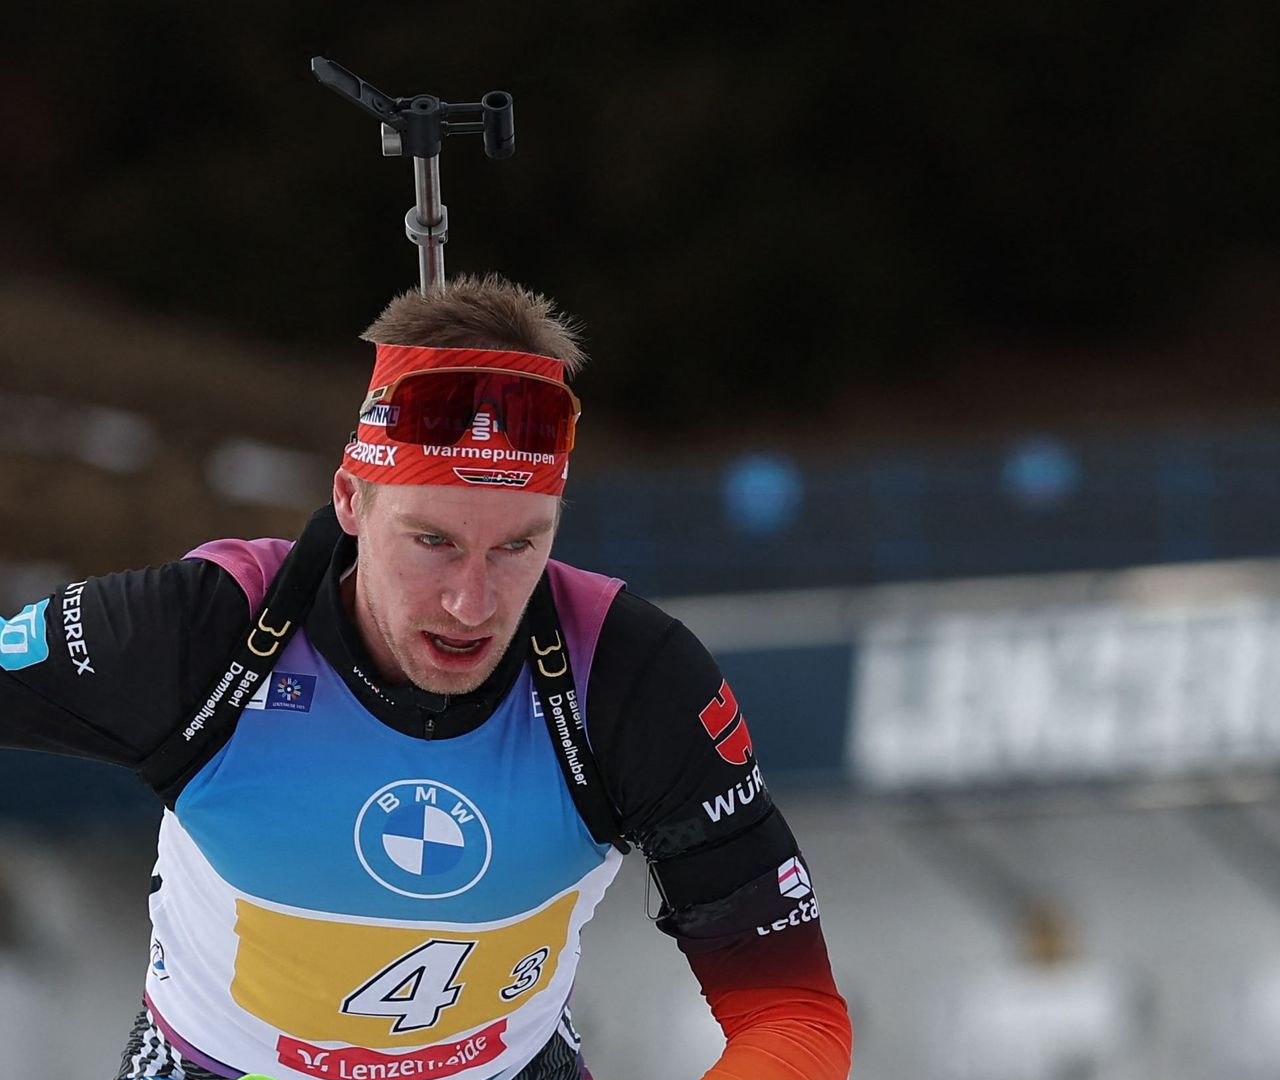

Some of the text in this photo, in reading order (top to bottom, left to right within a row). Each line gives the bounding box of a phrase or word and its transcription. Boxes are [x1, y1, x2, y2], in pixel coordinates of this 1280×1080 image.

[183, 661, 245, 741] Demmelhuber
[549, 694, 587, 786] Demmelhuber
[377, 786, 474, 824] BMW
[702, 762, 767, 823] WÜR
[338, 939, 549, 1035] 4 3
